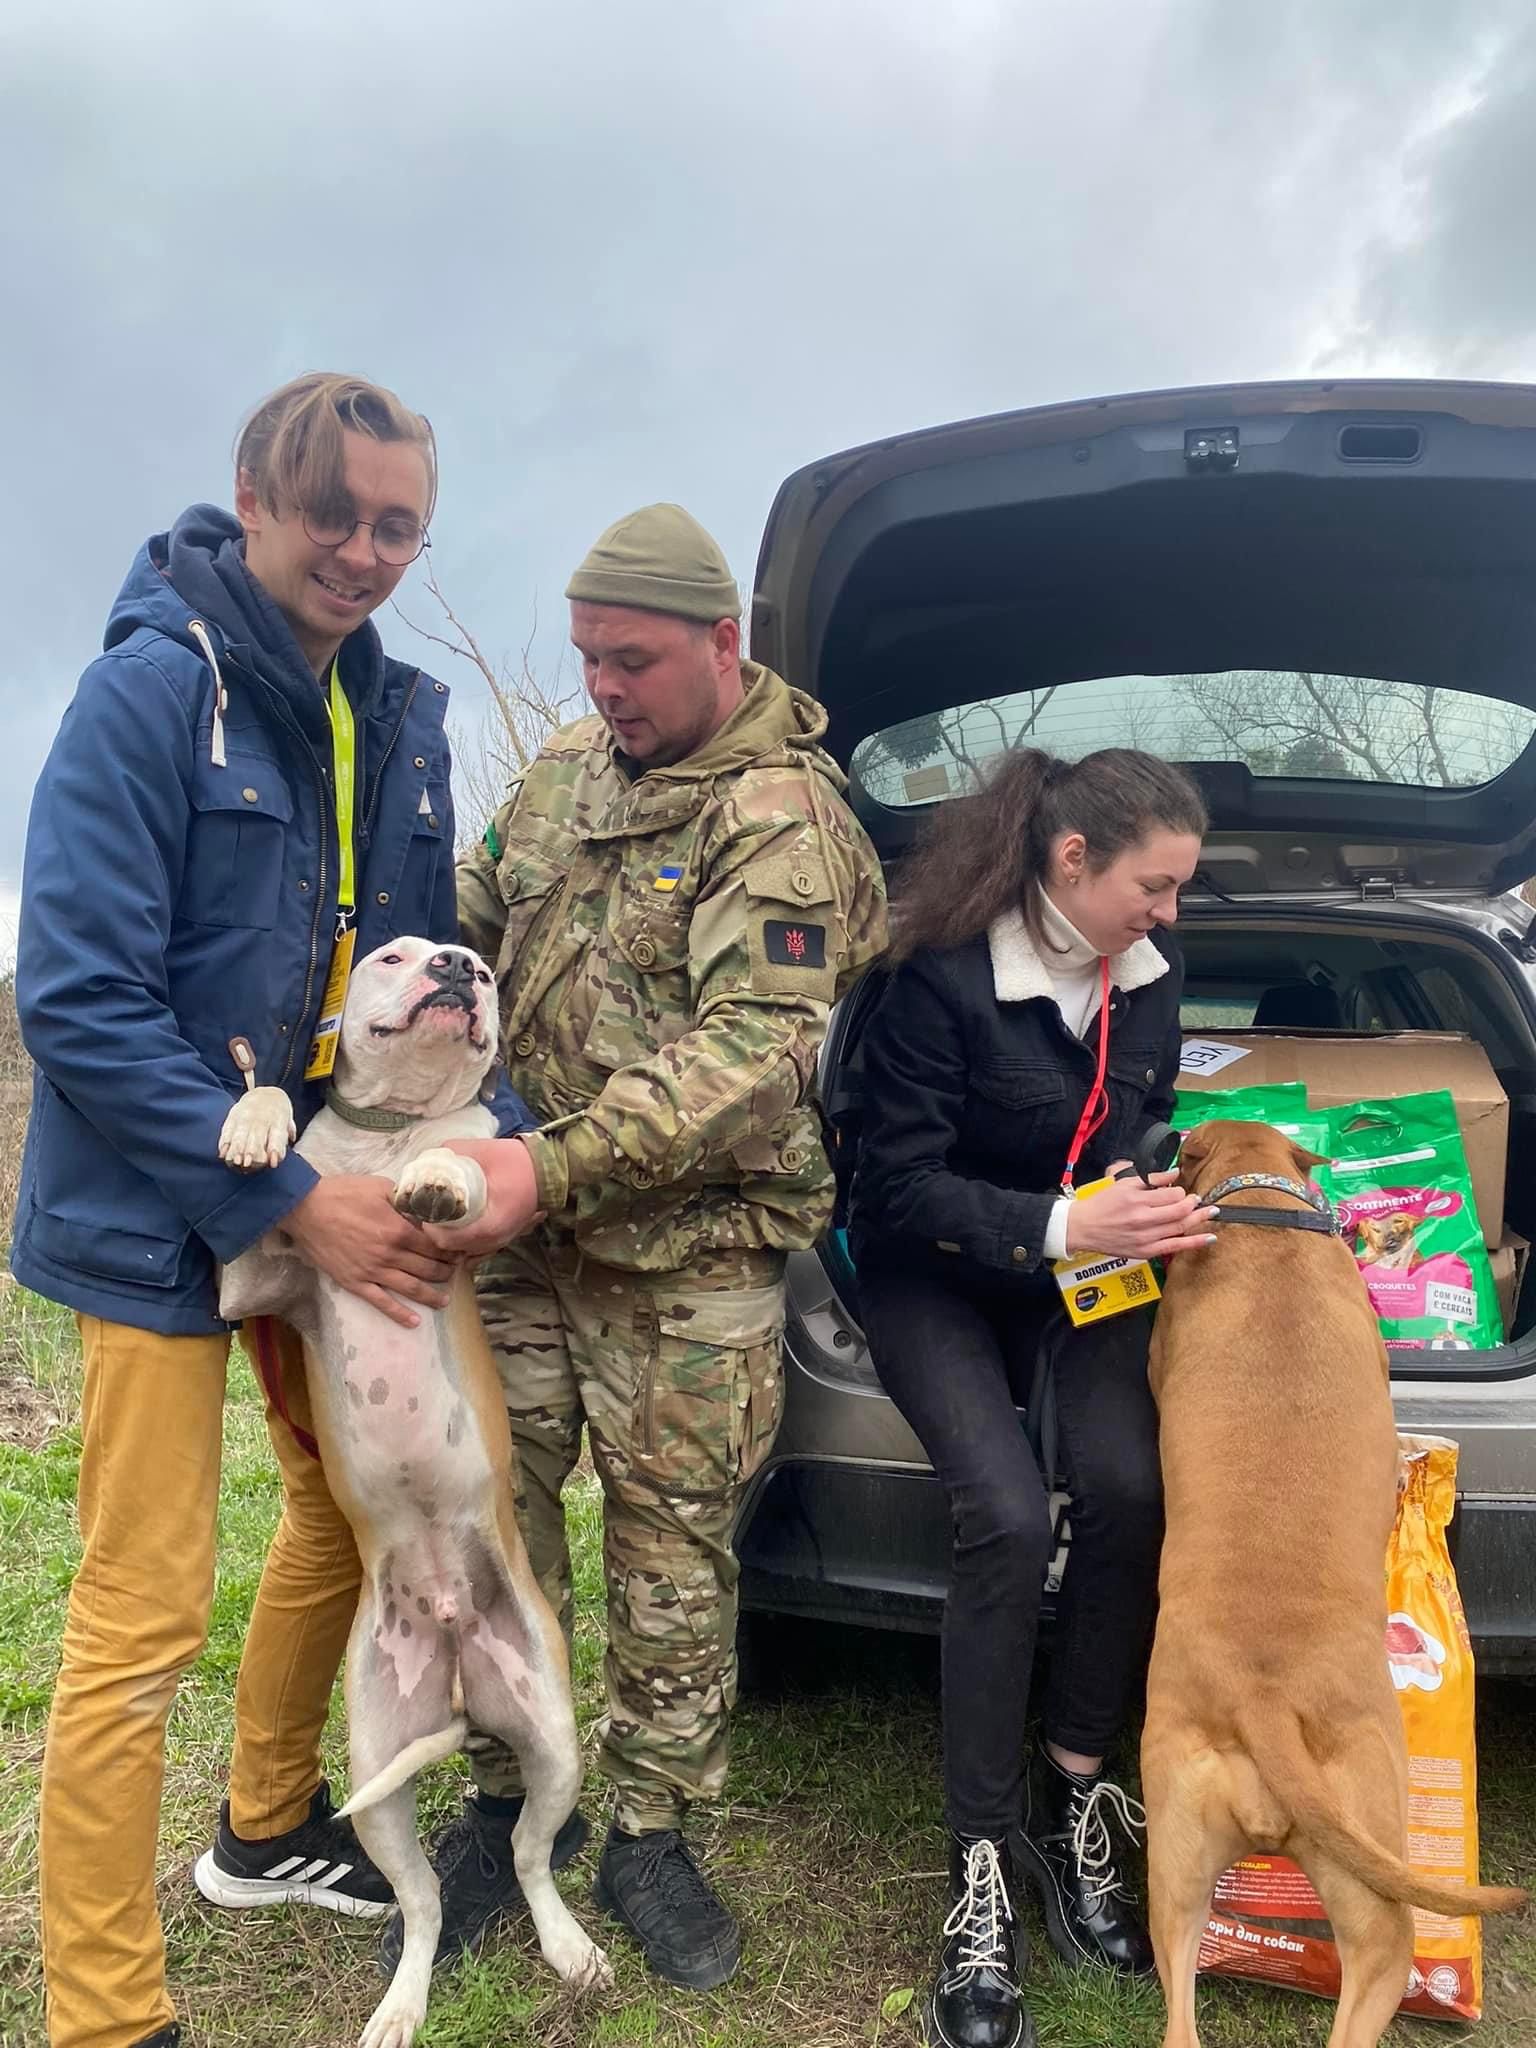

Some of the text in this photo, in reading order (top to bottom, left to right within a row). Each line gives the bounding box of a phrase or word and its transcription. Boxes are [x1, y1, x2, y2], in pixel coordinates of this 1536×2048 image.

[1075, 1257, 1129, 1281] ВОЛОНТЕР
[1368, 1282, 1416, 1291] CROQUETES
[1433, 1289, 1471, 1305] COM VACA
[1433, 1301, 1473, 1316] E CEREAIS
[1206, 1920, 1233, 1937] орм
[1235, 1924, 1261, 1944] для
[1263, 1935, 1305, 1953] собак
